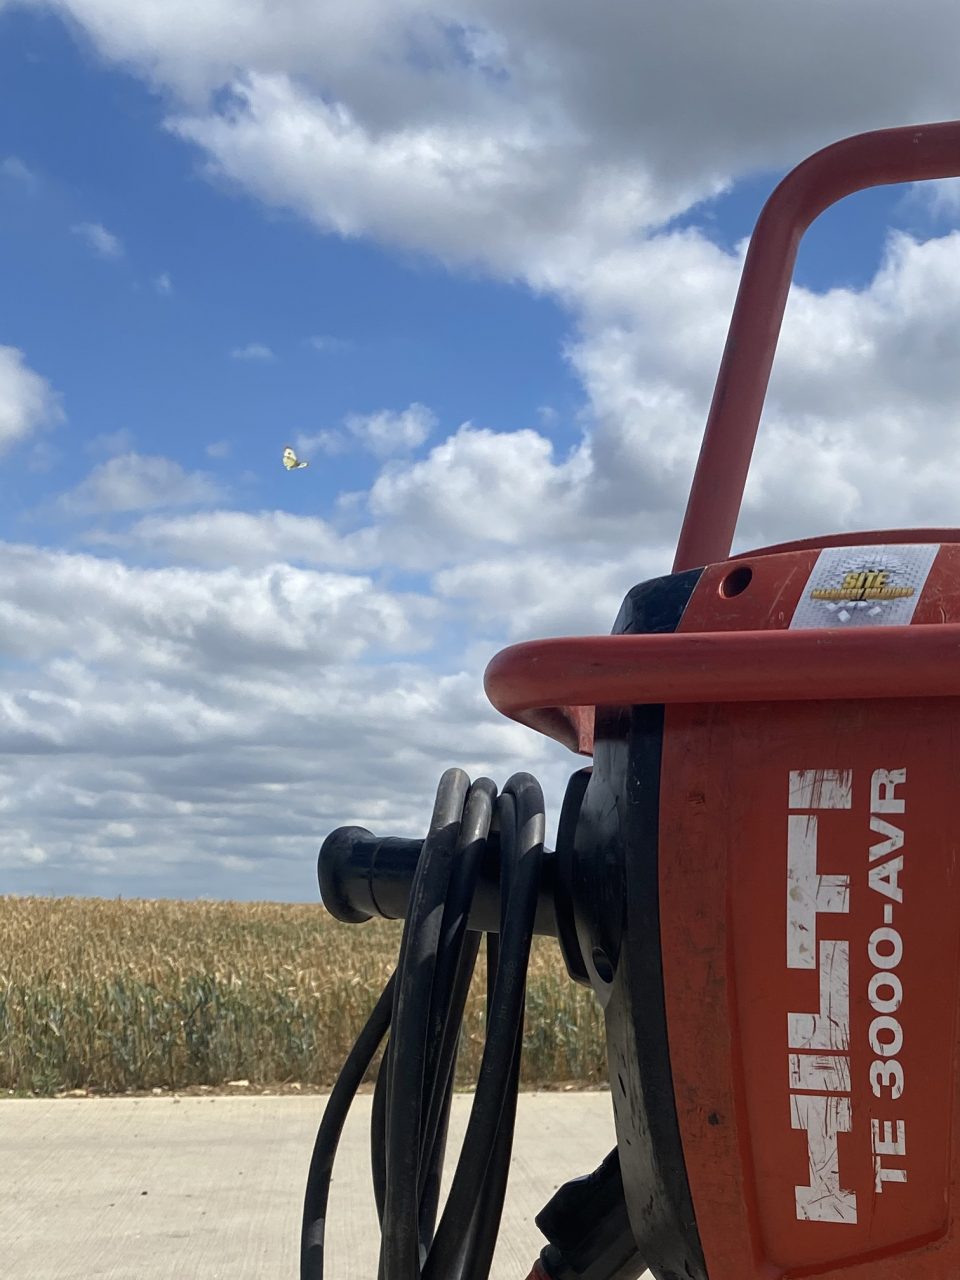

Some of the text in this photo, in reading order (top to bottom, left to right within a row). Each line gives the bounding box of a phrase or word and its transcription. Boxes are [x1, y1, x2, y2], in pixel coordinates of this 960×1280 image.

[811, 586, 915, 600] MACHINERY SOLUTIONS
[842, 571, 890, 588] SITE
[787, 769, 857, 1224] HILTI
[868, 767, 907, 1193] TE 3000-AVR
